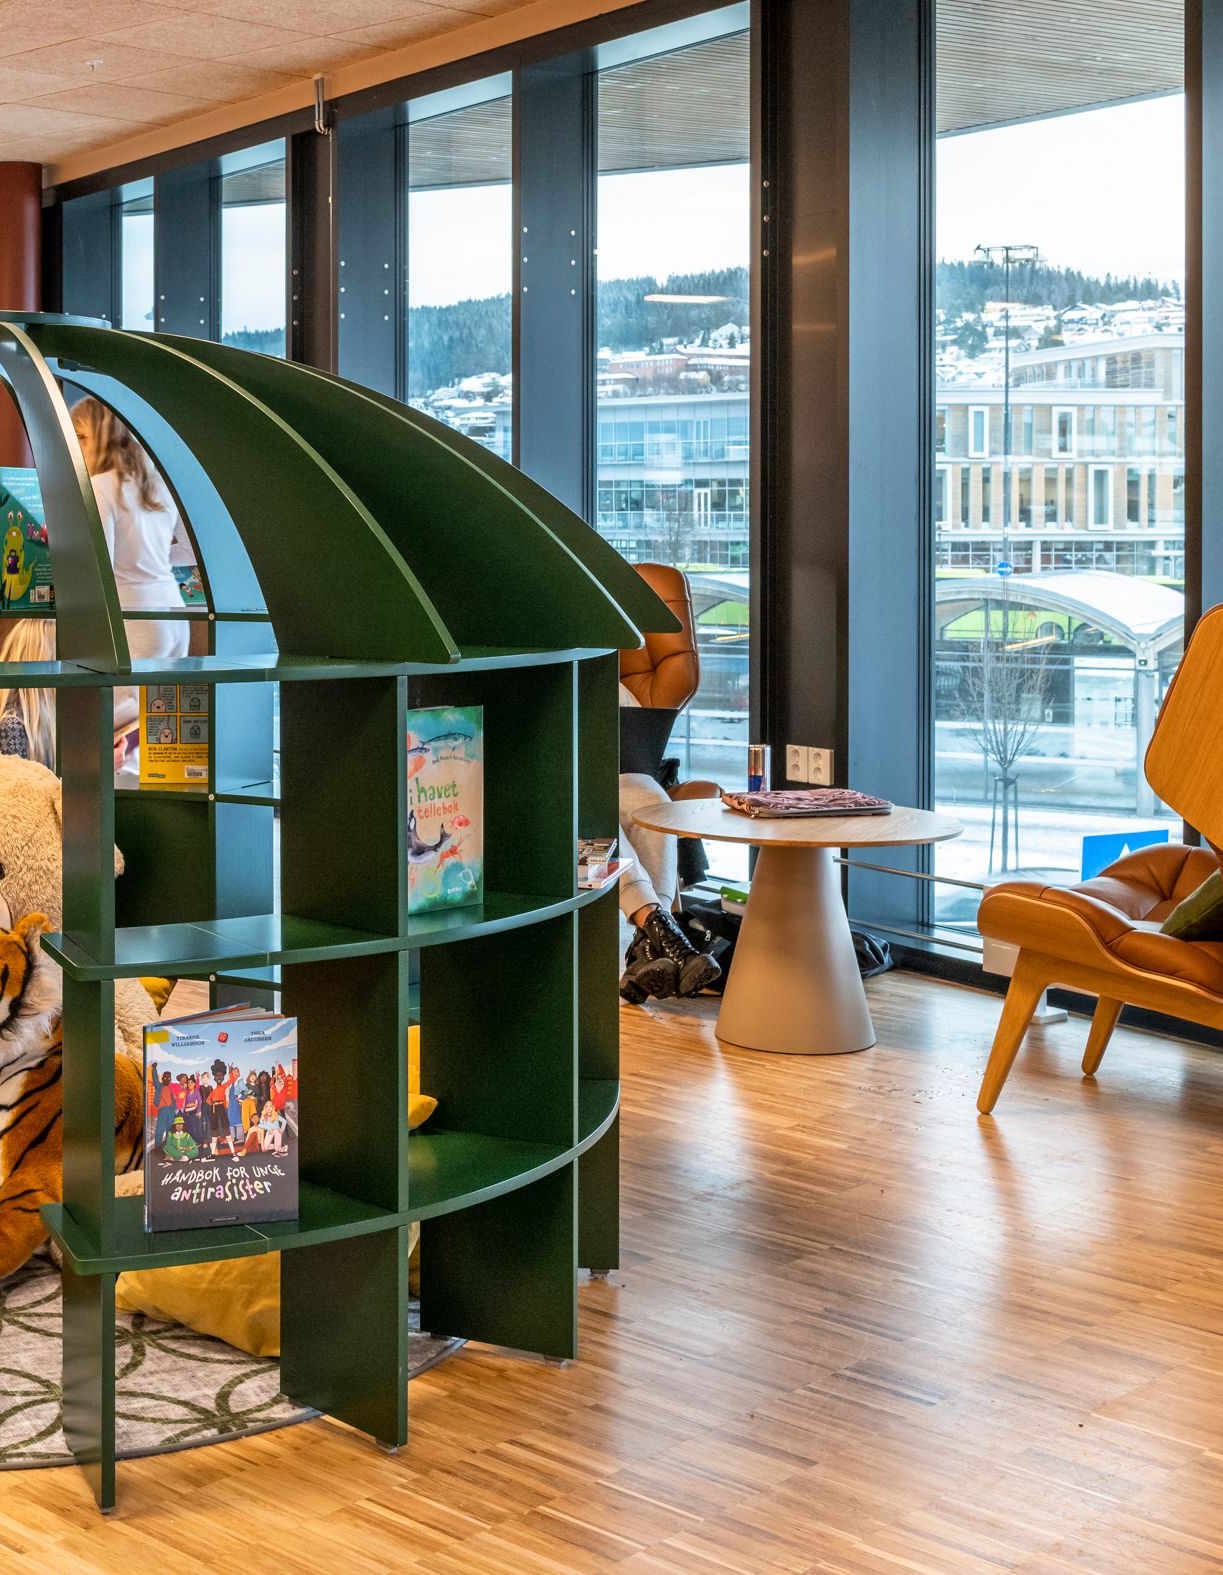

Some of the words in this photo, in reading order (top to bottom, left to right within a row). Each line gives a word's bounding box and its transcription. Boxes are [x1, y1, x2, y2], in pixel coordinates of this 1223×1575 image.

[409, 789, 413, 805] i
[415, 776, 458, 803] havet
[417, 799, 459, 820] tellebok
[226, 1167, 249, 1180] FOR
[252, 1165, 285, 1178] UNGE
[170, 1179, 272, 1204] antirasister
